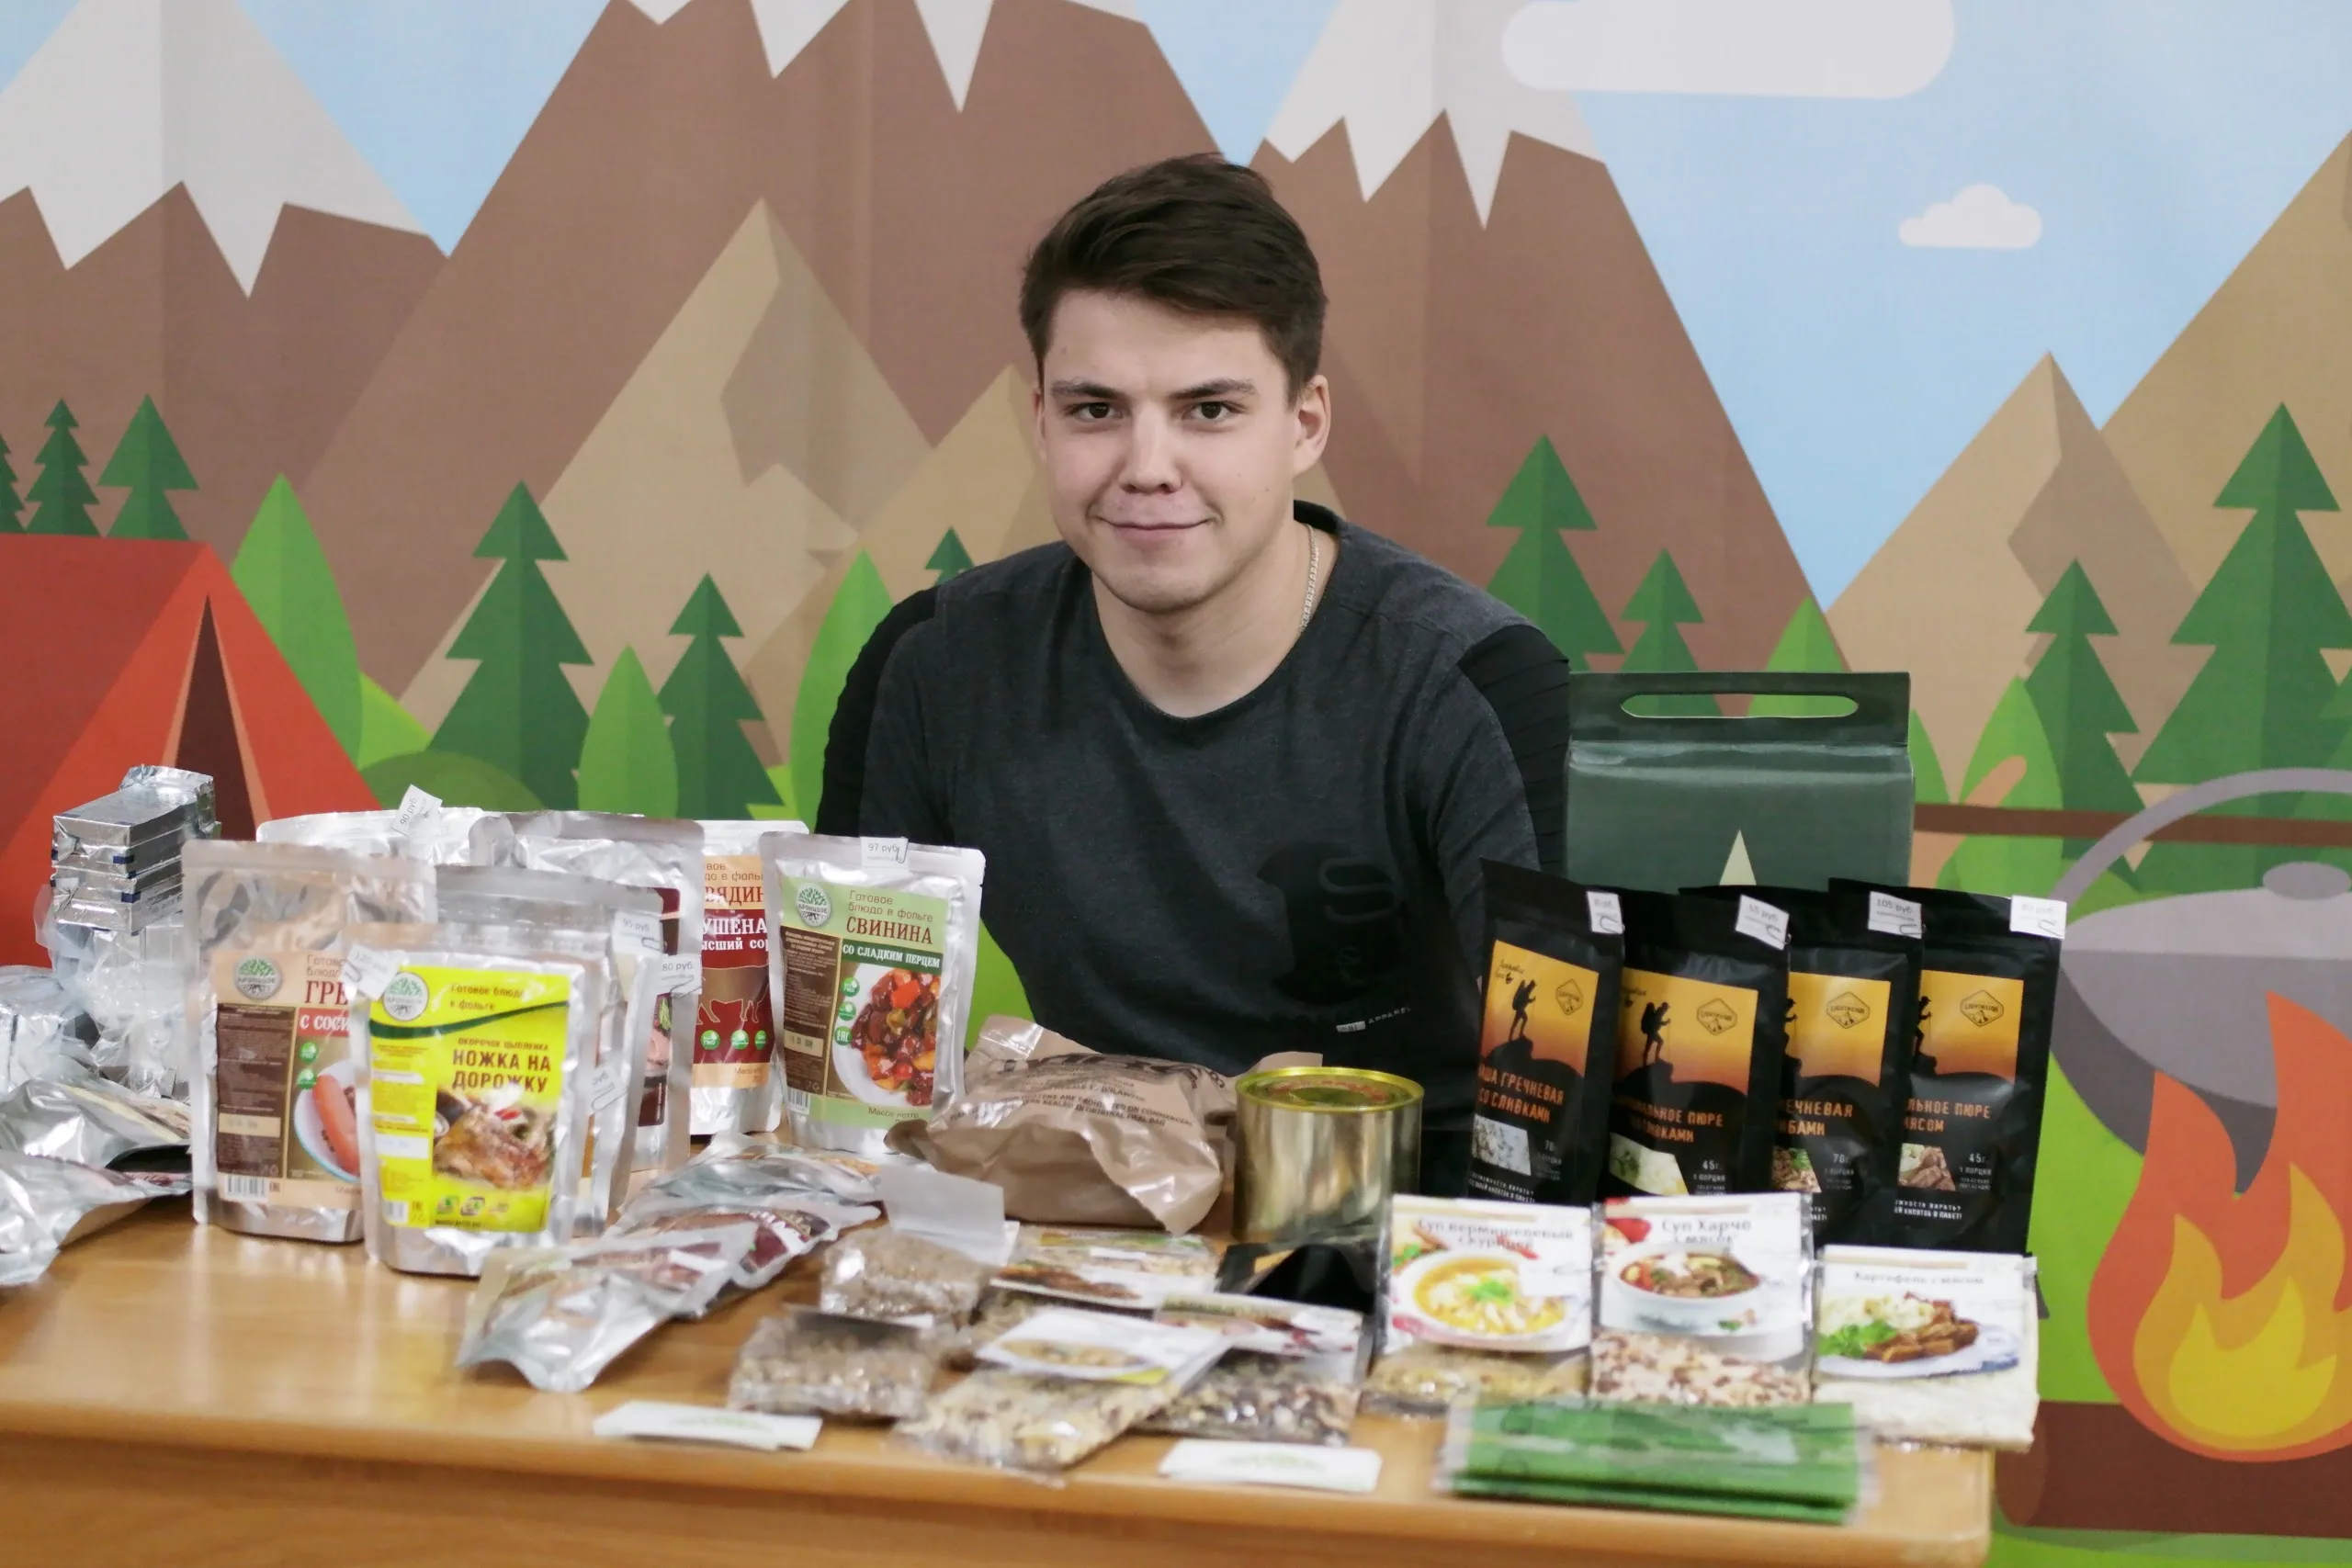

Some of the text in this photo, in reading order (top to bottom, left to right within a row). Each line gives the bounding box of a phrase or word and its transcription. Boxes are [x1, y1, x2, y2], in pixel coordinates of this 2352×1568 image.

[400, 797, 418, 825] 90 руб
[867, 842, 878, 852] 97
[721, 873, 728, 881] в
[849, 890, 893, 905] Готовое
[1876, 898, 1894, 909] 105
[848, 901, 933, 923] блюдо в фольге
[846, 916, 934, 945] СВИНИНА
[842, 943, 855, 955] СО
[857, 945, 903, 963] СЛАДКИМ
[905, 953, 941, 969] ПЕРЦЕМ
[662, 961, 694, 973] 80 руб
[450, 984, 490, 996] Готовое
[1368, 1006, 1411, 1024] APPAREL
[452, 1048, 520, 1071] НОЖКА
[527, 1054, 551, 1073] НА
[1499, 1071, 1565, 1107] ГРЕЧНЕВАЯ
[868, 1107, 894, 1118] Масса
[1490, 1090, 1551, 1124] СЛИВКАМИ
[1954, 1102, 1991, 1119] ПЮРЕ
[1141, 1107, 1193, 1127] COMMERCIAL
[1687, 1111, 1724, 1128] ПЮРЕ
[1418, 1217, 1574, 1240] Суп вермишелевый
[1661, 1218, 1752, 1238] Суп Харчо
[1854, 1270, 1928, 1285] Картофель
